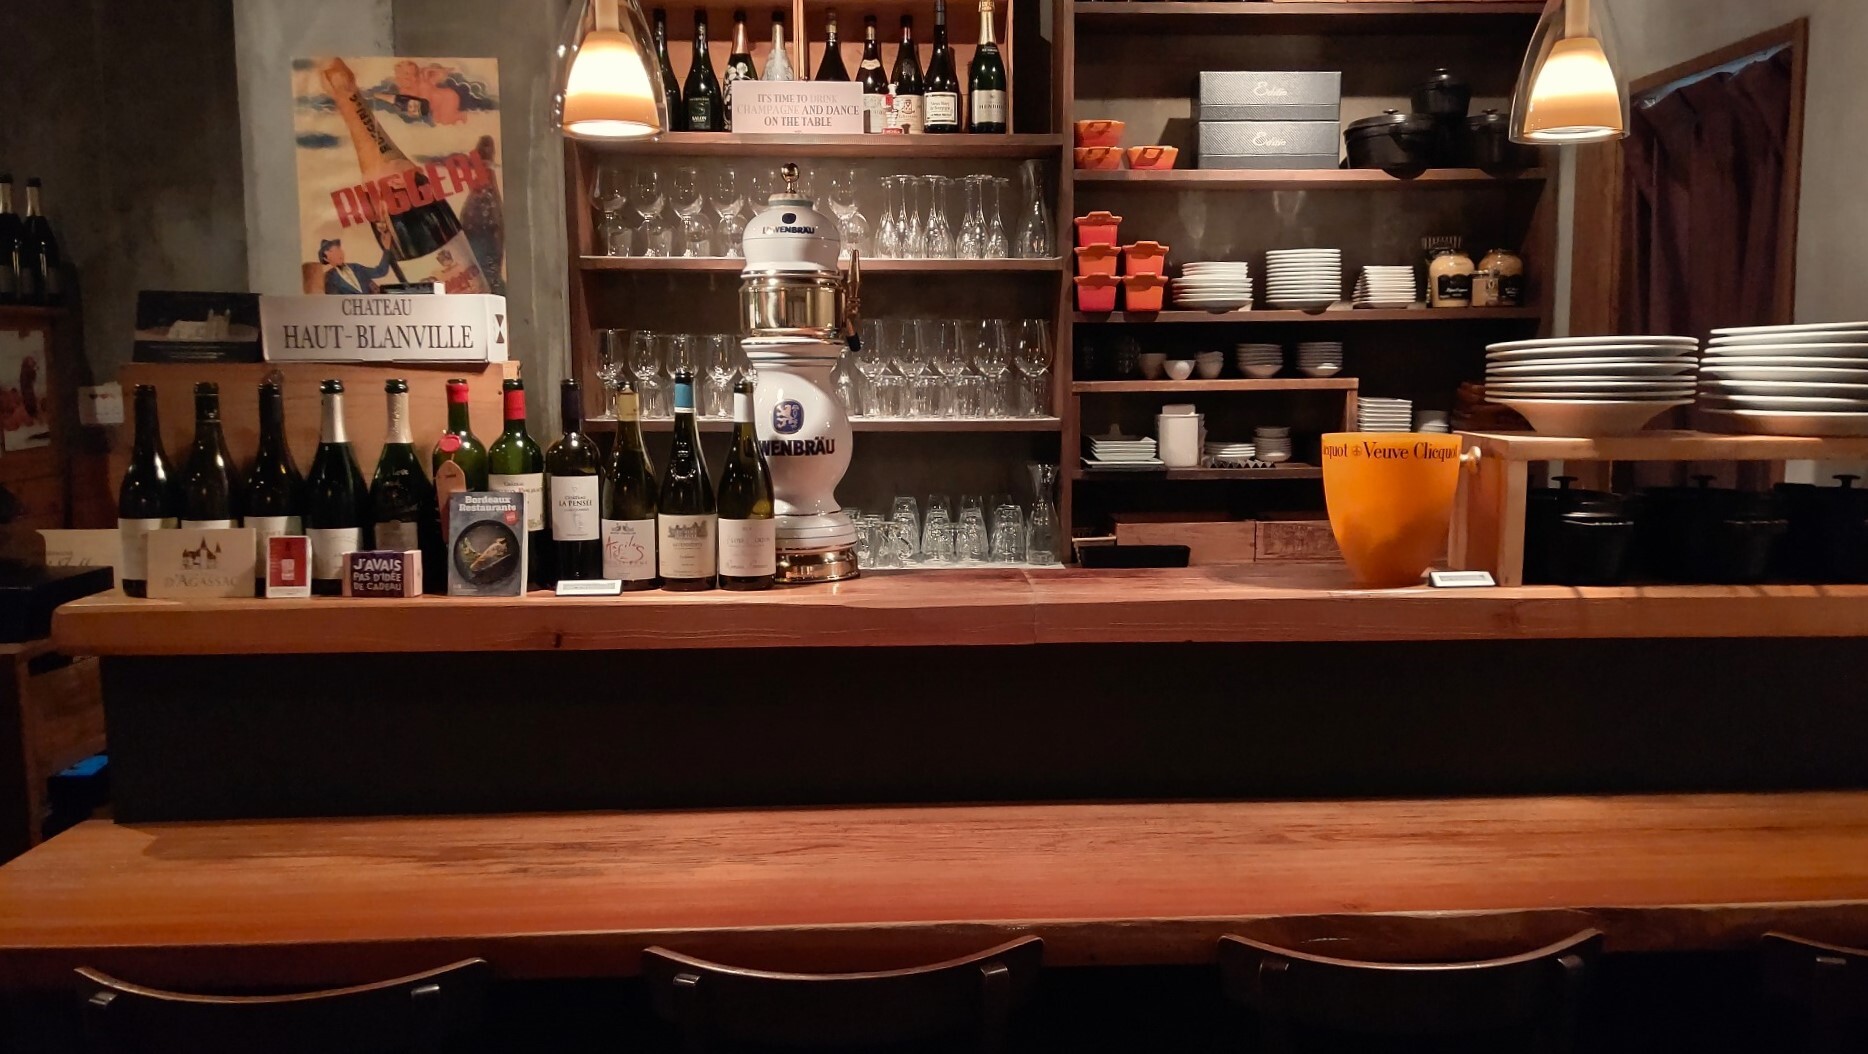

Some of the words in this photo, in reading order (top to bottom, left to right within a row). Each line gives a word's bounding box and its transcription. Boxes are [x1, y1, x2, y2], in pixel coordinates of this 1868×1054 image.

[757, 94, 772, 103] IT'S
[774, 94, 795, 103] TIME
[796, 94, 808, 102] TO
[810, 93, 838, 102] DRINK
[737, 104, 800, 115] CHAMPAGNE
[802, 105, 824, 115] AND
[825, 105, 860, 115] DANCE
[764, 116, 778, 126] ON
[781, 116, 800, 126] THE
[802, 116, 832, 127] TABLE
[331, 149, 492, 229] RUGGERI
[763, 226, 815, 235] LWENBRÄU
[342, 298, 413, 316] CHATEAU
[283, 325, 475, 349] HAUT-BLANVILLE
[758, 436, 836, 457] WENBRÄU
[1363, 441, 1409, 460] Veuve
[1413, 441, 1458, 463] Clicquot
[464, 495, 512, 504] Bordeaux
[353, 558, 402, 572] J'AVAIS
[353, 572, 370, 582] PAS
[373, 571, 402, 582] D'IDÉE
[353, 582, 364, 591] DE
[366, 582, 402, 591] CADEAU
